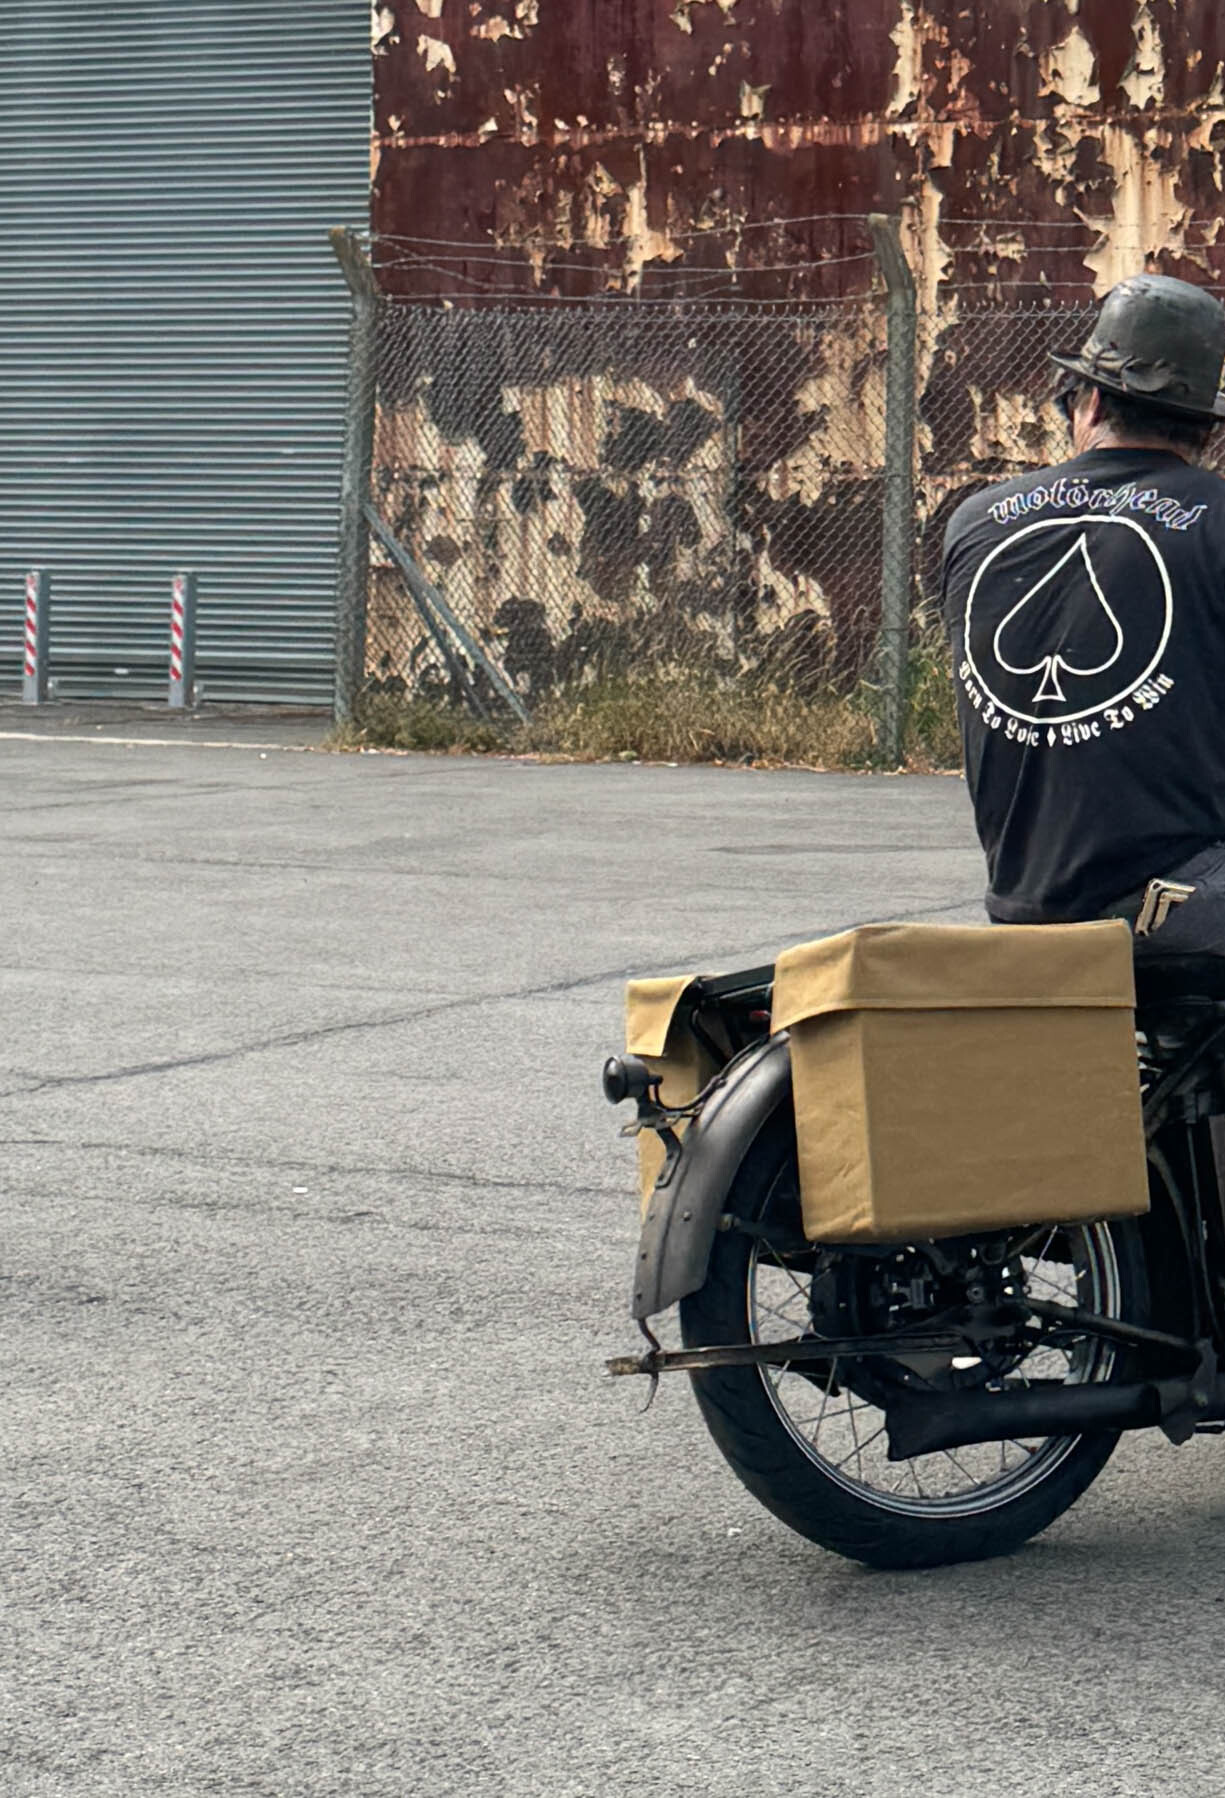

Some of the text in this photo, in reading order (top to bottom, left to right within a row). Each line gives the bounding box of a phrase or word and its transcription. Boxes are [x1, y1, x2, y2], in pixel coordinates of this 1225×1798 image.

[959, 661, 983, 709] Born
[982, 702, 1002, 729] To
[1061, 722, 1101, 745] Live
[1103, 705, 1134, 730] To
[1133, 674, 1175, 710] Win
